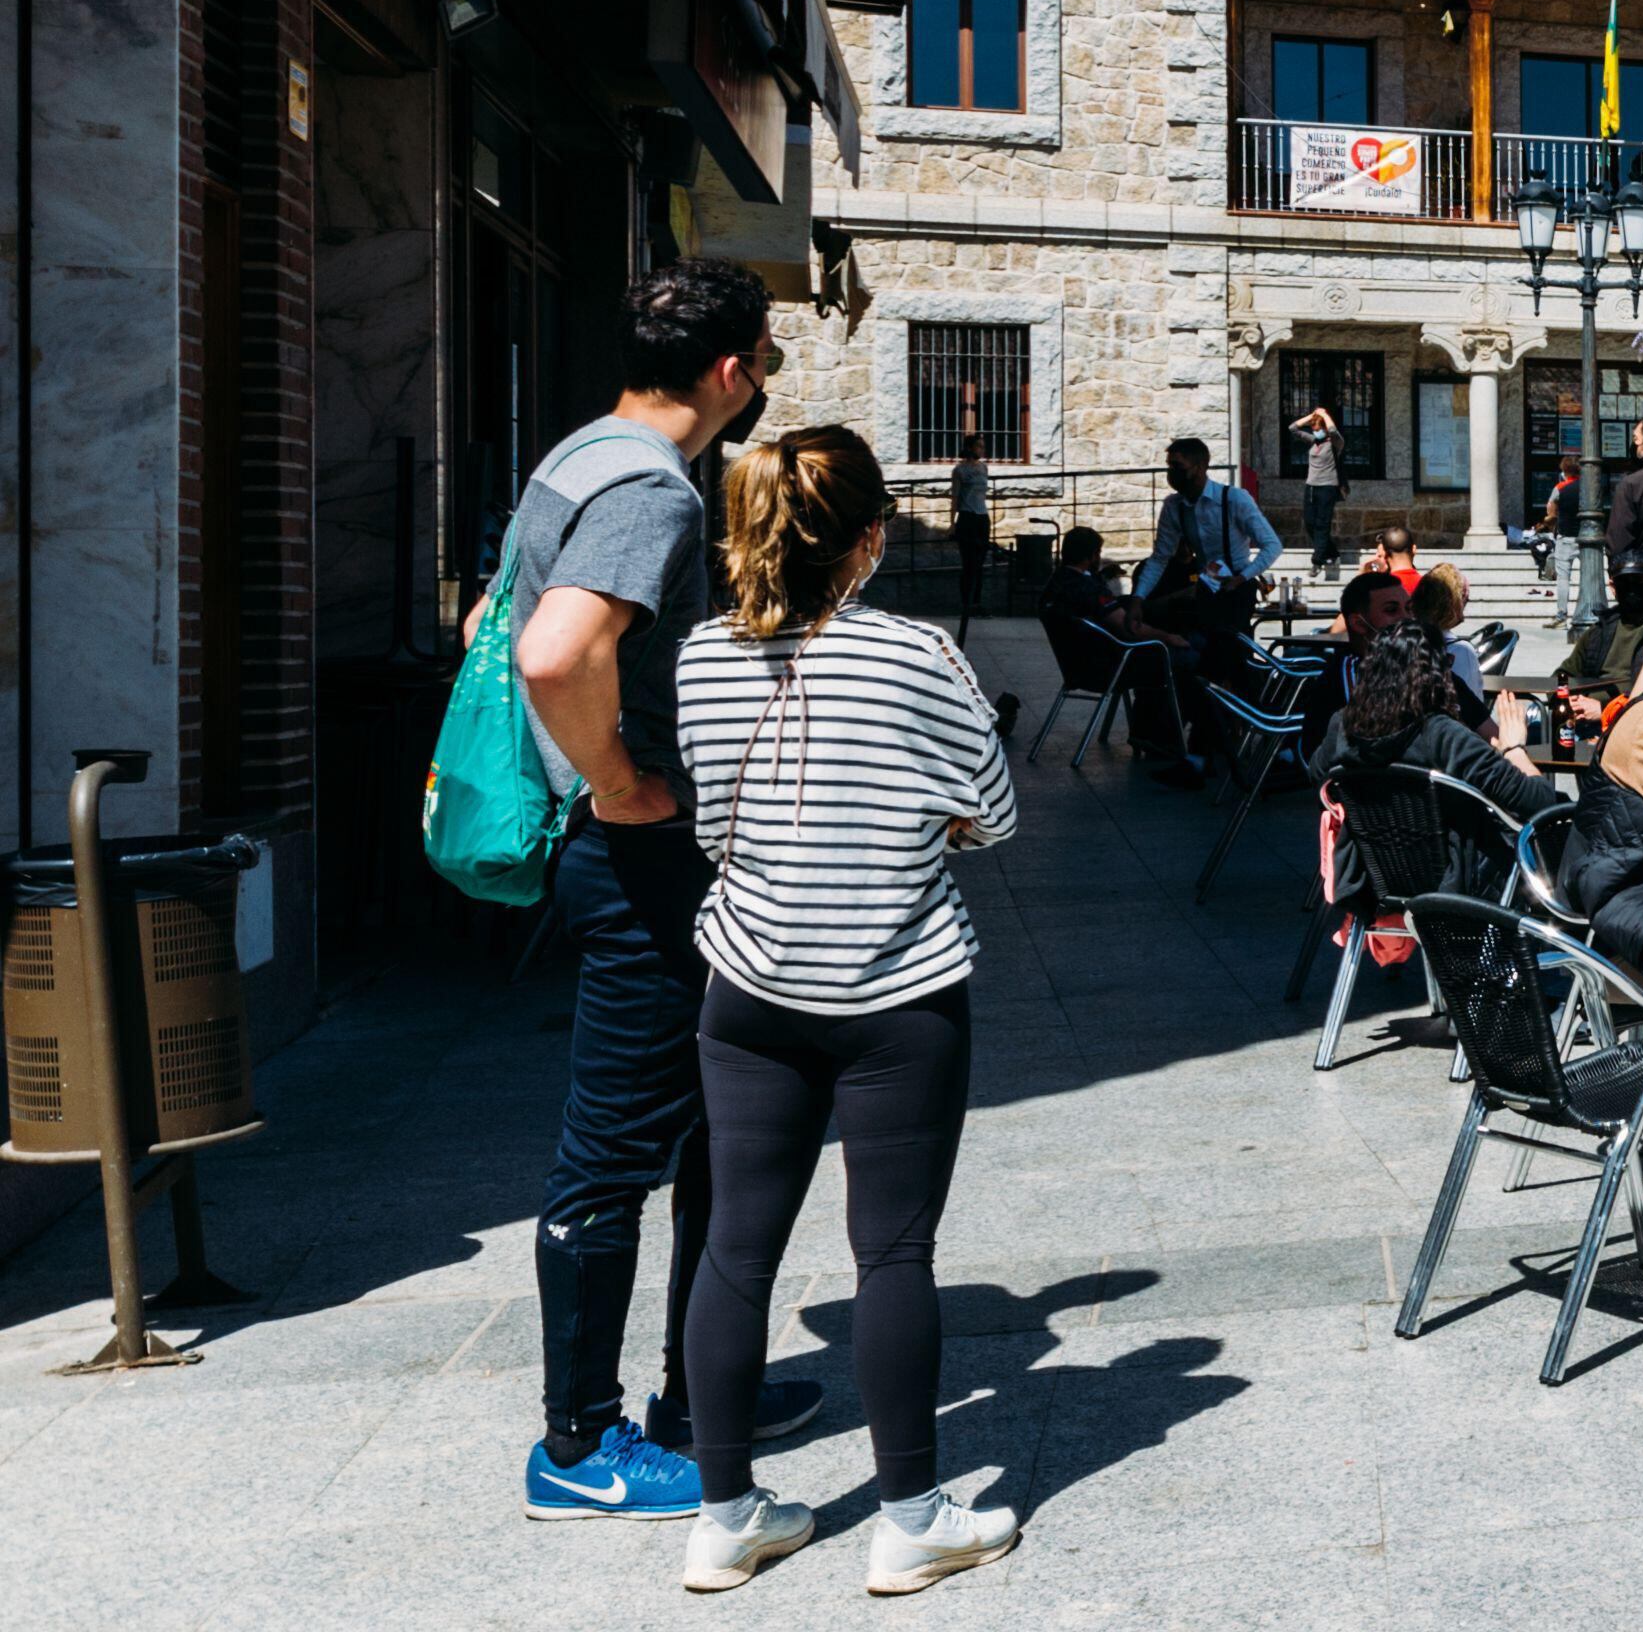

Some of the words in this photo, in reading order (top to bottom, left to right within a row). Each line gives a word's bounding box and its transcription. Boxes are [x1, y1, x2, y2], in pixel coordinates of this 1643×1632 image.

[1307, 133, 1346, 144] NUESTRO
[1297, 170, 1306, 180] ES
[1310, 171, 1320, 181] TU
[1323, 172, 1345, 182] GRAN
